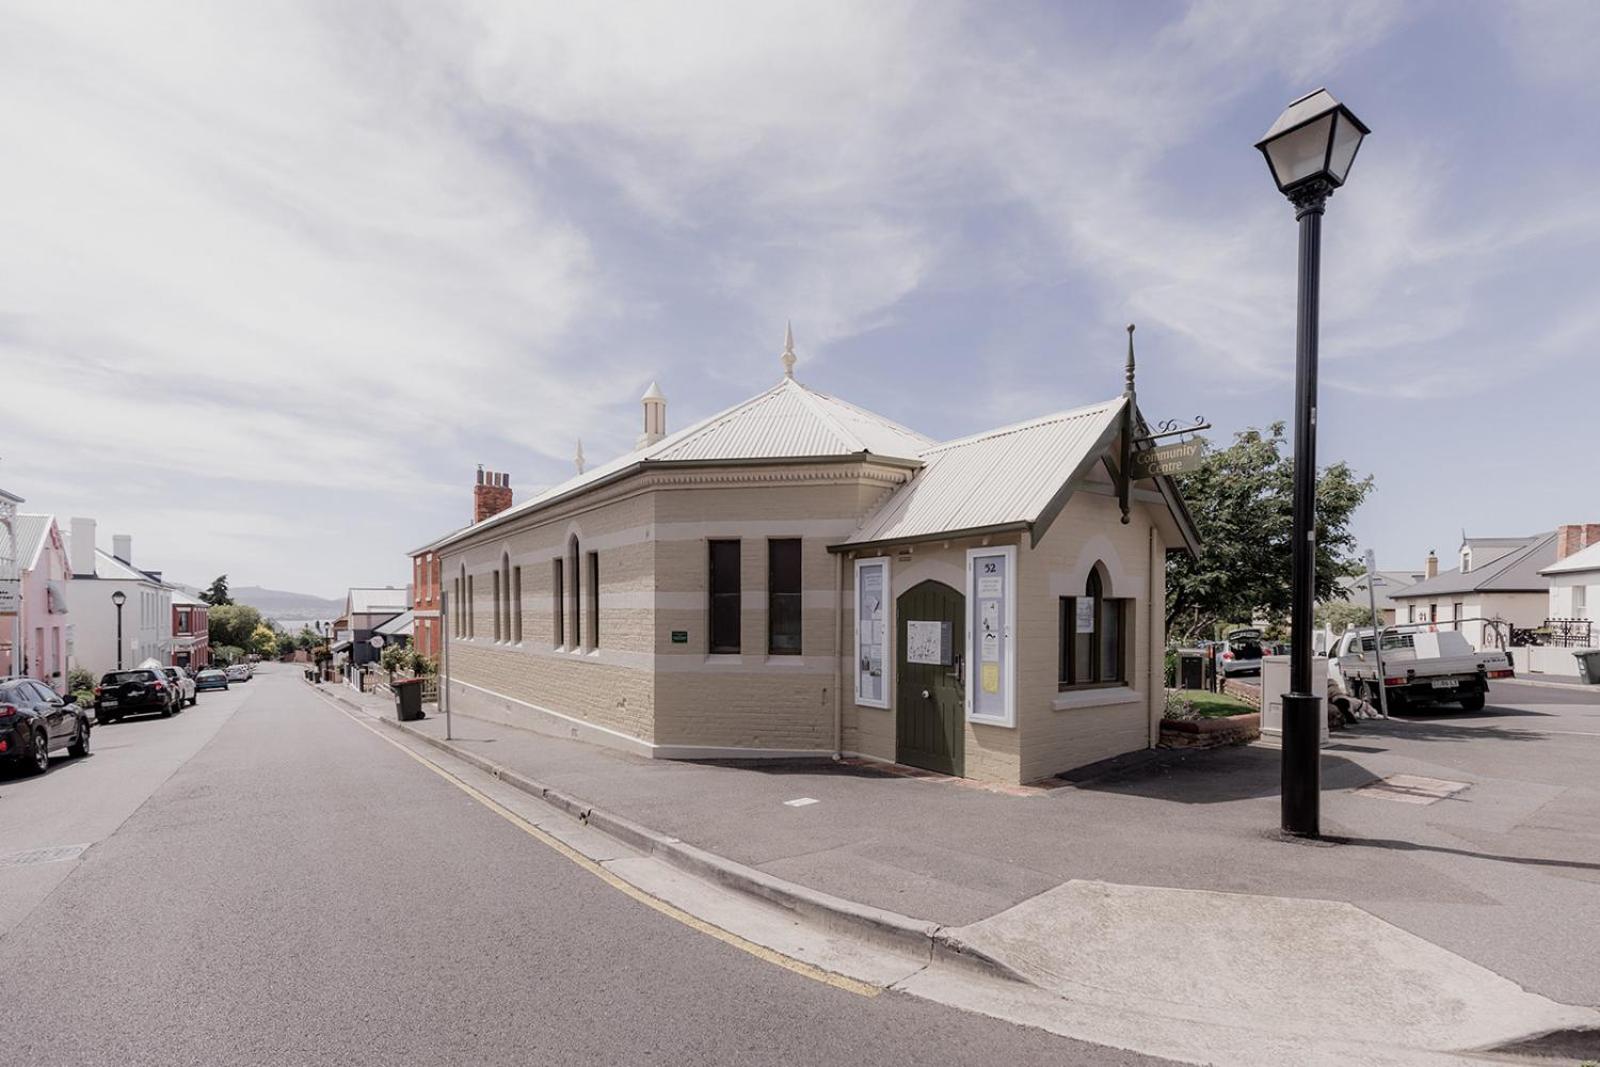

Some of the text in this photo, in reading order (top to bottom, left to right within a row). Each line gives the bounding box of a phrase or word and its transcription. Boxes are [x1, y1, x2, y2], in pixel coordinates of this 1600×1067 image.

[1136, 445, 1198, 465] Community
[1148, 460, 1183, 475] Centre
[984, 563, 997, 573] 52
